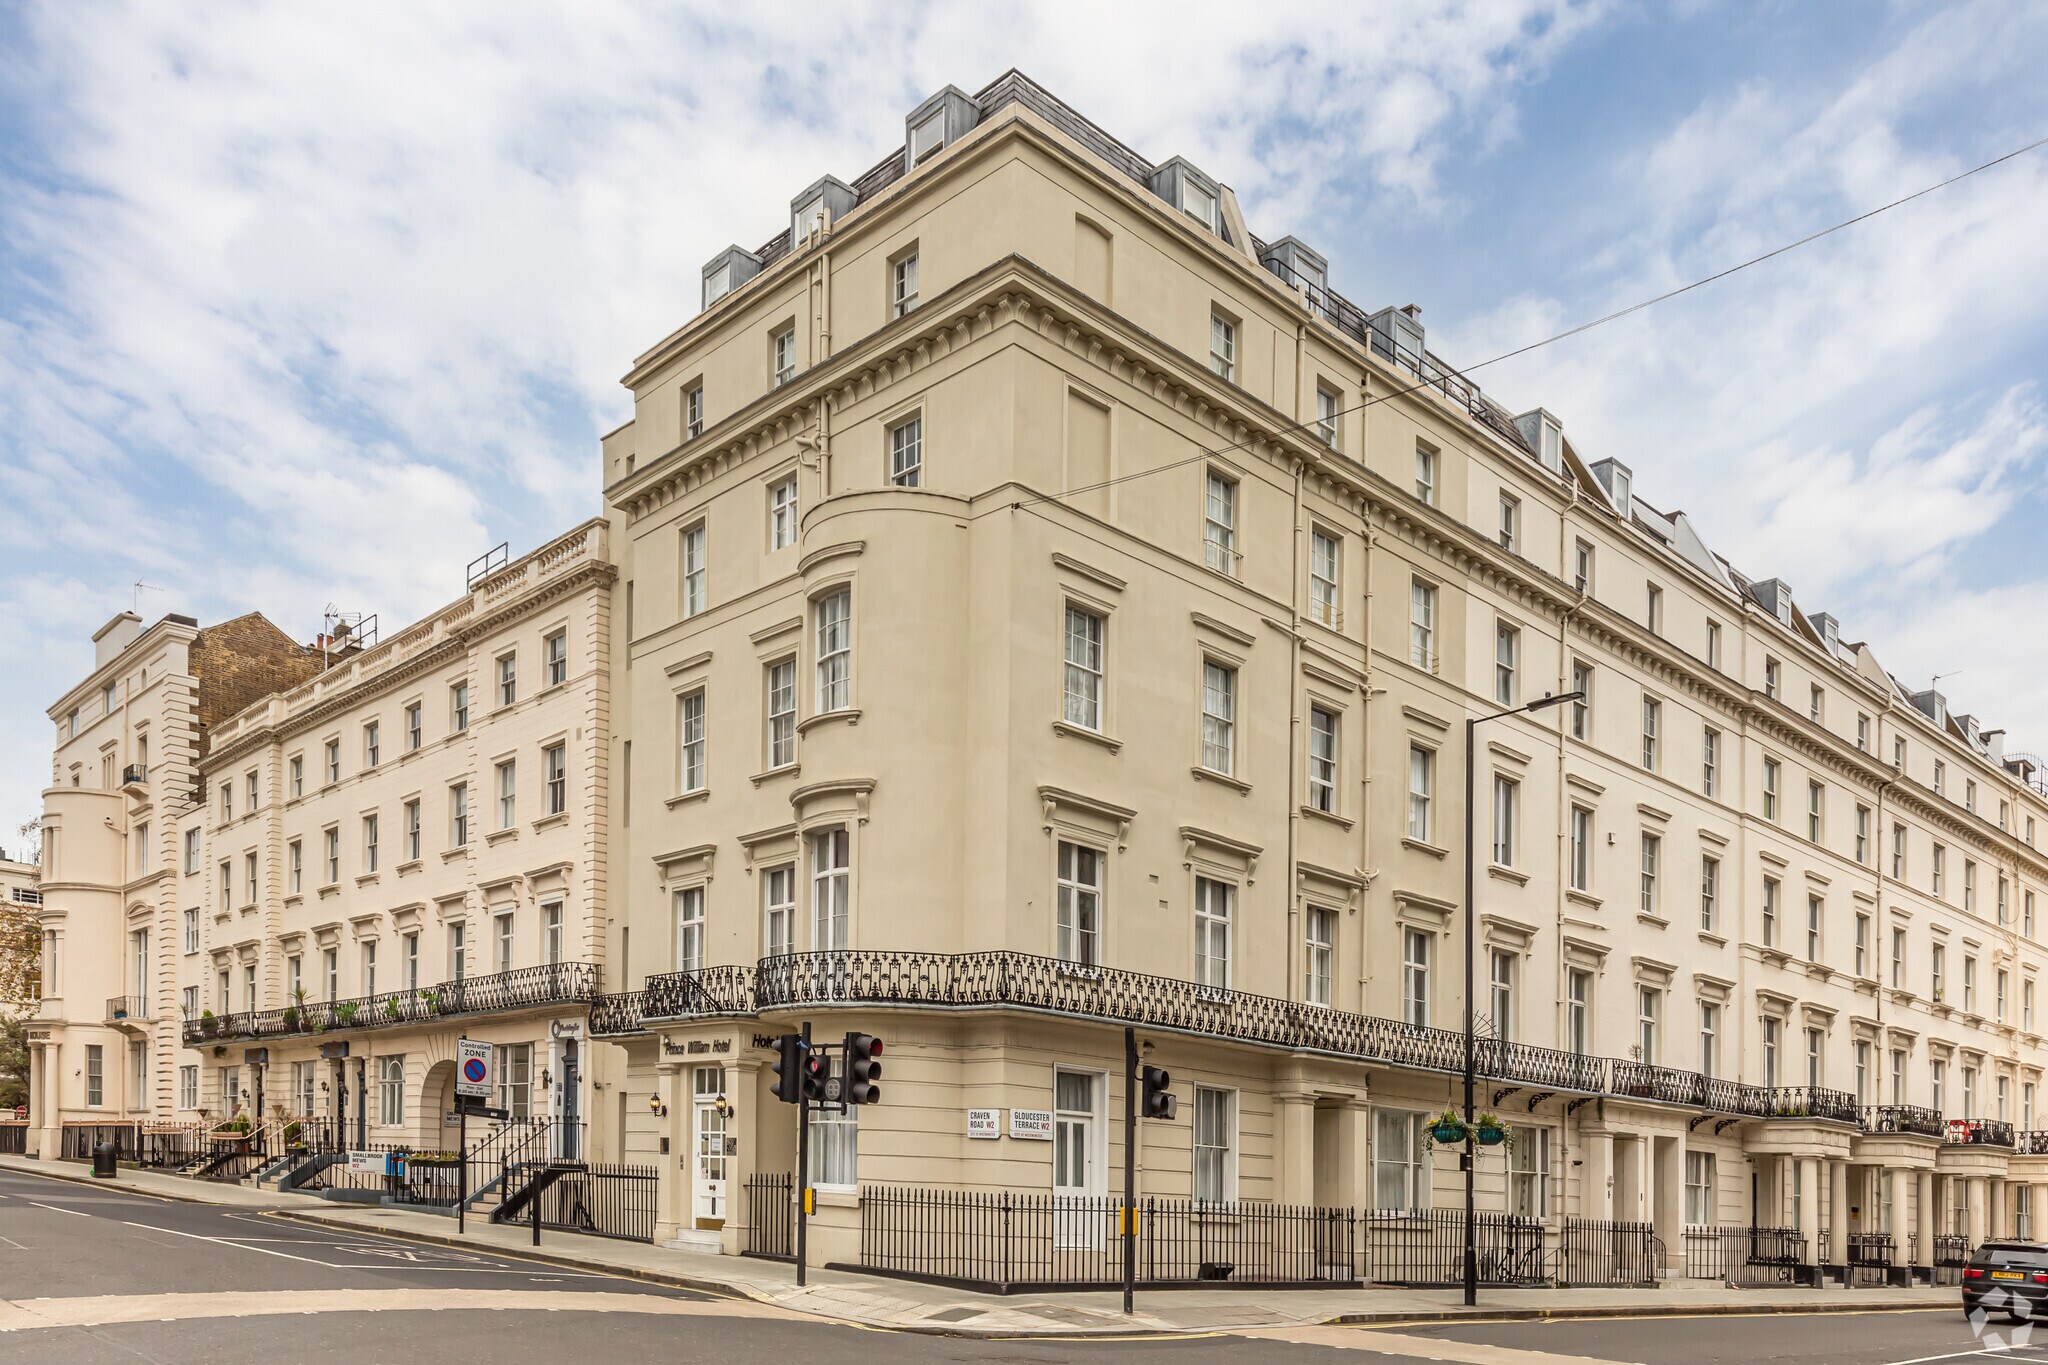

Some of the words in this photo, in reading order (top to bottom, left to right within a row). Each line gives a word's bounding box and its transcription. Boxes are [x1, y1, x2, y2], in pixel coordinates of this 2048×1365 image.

[460, 1041, 491, 1051] Controlled
[752, 1033, 780, 1049] Hote
[665, 1042, 685, 1056] Prince
[687, 1040, 710, 1054] William
[712, 1038, 732, 1053] Hotel
[464, 1049, 486, 1058] ZONE
[970, 1111, 990, 1120] CRAVEN
[1014, 1111, 1050, 1122] GLOUCESTER
[970, 1121, 984, 1129] ROAD
[986, 1121, 995, 1129] W2
[1014, 1120, 1040, 1130] TERRACE
[1041, 1122, 1050, 1131] W2
